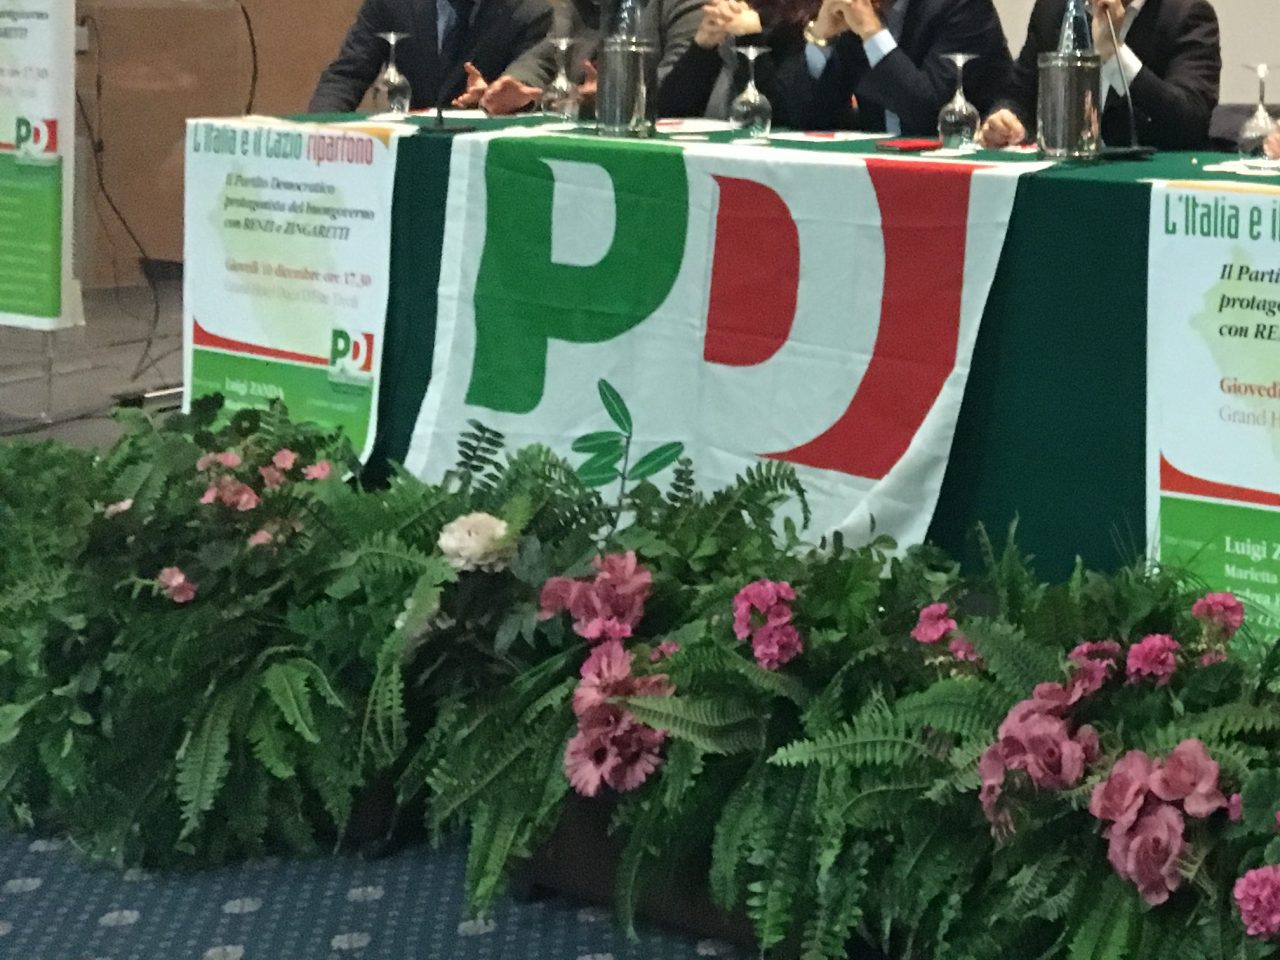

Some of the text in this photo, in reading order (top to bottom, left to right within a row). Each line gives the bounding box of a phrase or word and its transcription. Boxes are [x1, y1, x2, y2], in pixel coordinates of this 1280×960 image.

[15, 116, 58, 154] PD
[241, 128, 249, 156] e
[253, 126, 262, 157] il
[266, 128, 303, 160] Lazio
[307, 133, 374, 167] ripartono
[271, 177, 336, 195] Democratico
[1165, 194, 1239, 239] L'Italia
[1249, 206, 1262, 241] e
[1219, 264, 1233, 280] Il
[465, 137, 985, 480] PD
[1218, 323, 1249, 339] con
[330, 328, 374, 372] PD
[1219, 406, 1267, 426] Grand
[1225, 536, 1267, 562] Luigi
[1224, 564, 1278, 584] Marietta
[1226, 588, 1271, 606] ndrea
